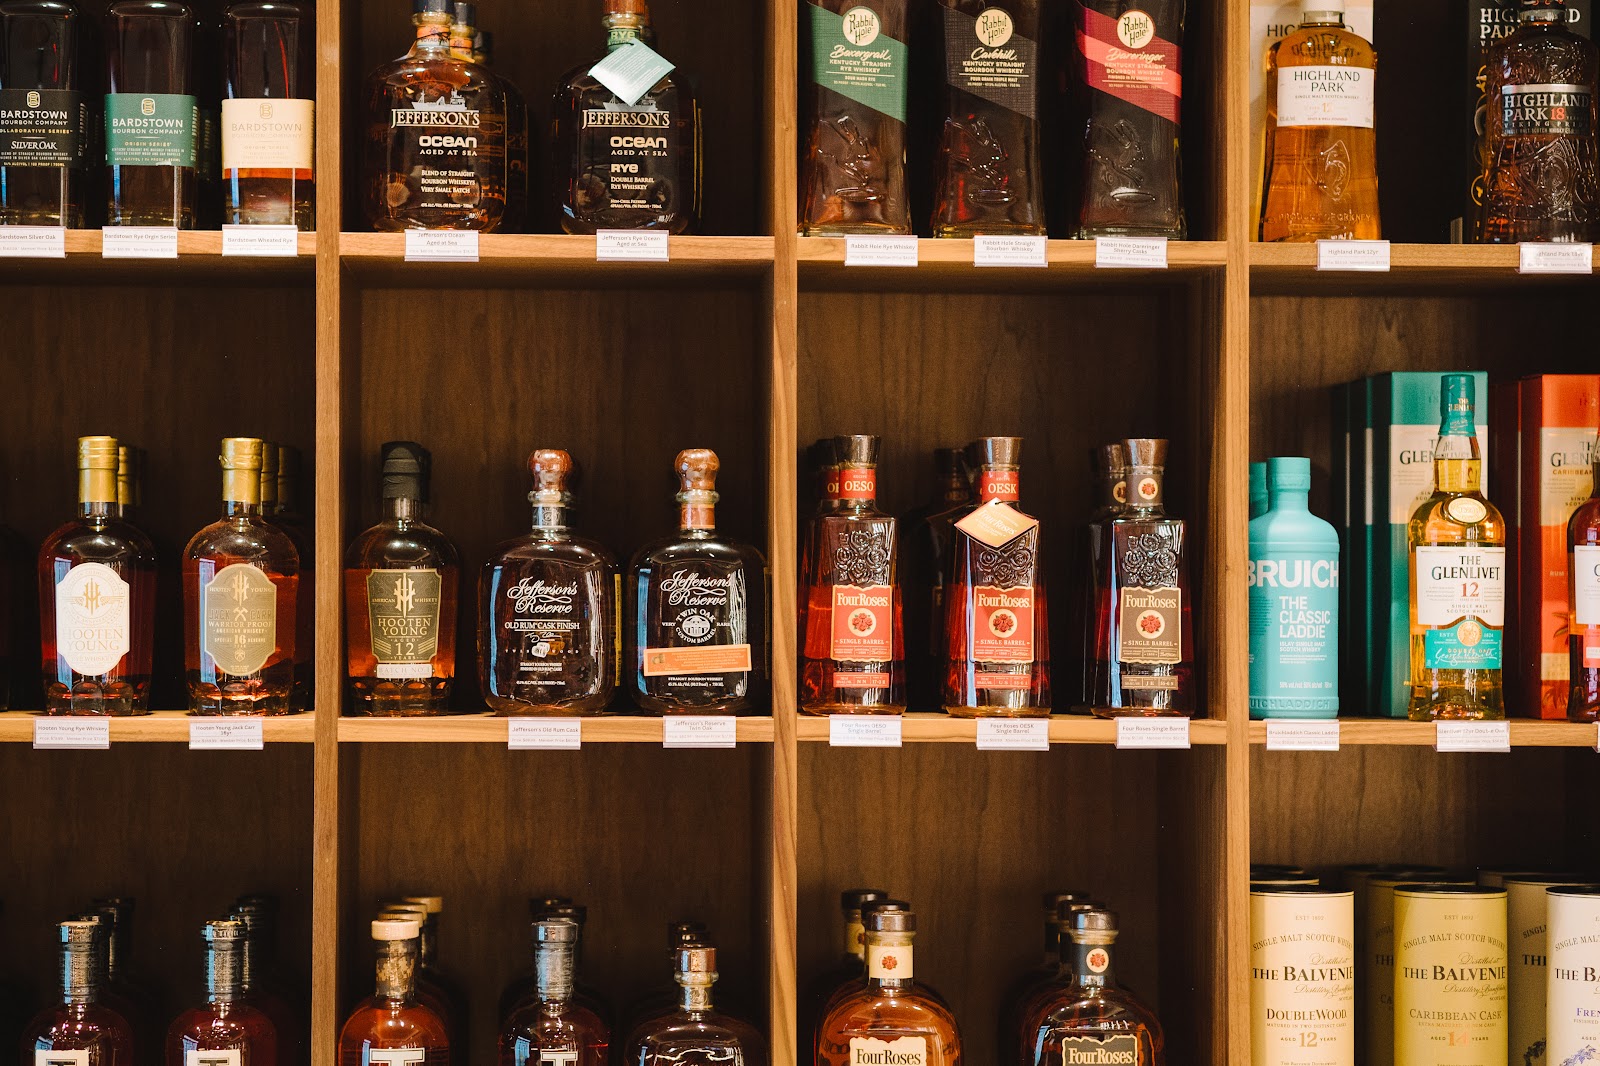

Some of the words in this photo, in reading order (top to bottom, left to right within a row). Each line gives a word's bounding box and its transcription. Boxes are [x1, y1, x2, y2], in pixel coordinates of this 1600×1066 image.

[849, 13, 875, 34] Rabbit
[982, 15, 1007, 34] Rabbit
[1123, 16, 1148, 36] Rabbit
[1294, 71, 1360, 81] HIGHLAND
[1311, 82, 1345, 92] PARK
[1503, 94, 1589, 108] HIGHLAND
[1, 110, 68, 119] BARDSTOWN
[391, 109, 480, 128] JEFFERSON'S
[582, 110, 670, 129] JEFFERSON'S
[1504, 107, 1549, 122] PARK
[1550, 107, 1566, 120] 18
[112, 118, 183, 127] BARDSTOWN
[231, 123, 302, 132] BARDSTOWN
[11, 141, 38, 150] SILVER
[38, 141, 58, 150] OAK
[844, 480, 874, 492] OESO
[988, 483, 1017, 494] OESK
[1459, 555, 1481, 565] THE
[1431, 566, 1500, 580] GLENLIVET
[507, 576, 577, 599] Jefferson's
[1461, 582, 1479, 598] 12
[515, 596, 572, 613] Reserve
[669, 589, 727, 606] Reserve
[1279, 596, 1308, 610] THE
[378, 618, 431, 628] HOOTEN
[676, 608, 697, 625] TWIN
[699, 608, 716, 625] OAK
[1279, 610, 1331, 624] CLASSIC
[382, 627, 427, 636] YOUNG
[1279, 625, 1326, 639] LADDIE
[67, 640, 119, 652] YOUNG
[396, 643, 415, 656] 12
[1253, 936, 1278, 951] SINGLE
[1280, 933, 1302, 943] MALT
[1306, 933, 1335, 943] SCOTCH
[1403, 936, 1427, 951] SINGLE
[1429, 933, 1451, 943] MALT
[1455, 933, 1486, 943] SCOTCH
[1252, 967, 1279, 981] THE
[1283, 966, 1353, 981] BALVENIE
[1403, 967, 1428, 980] THE
[1432, 965, 1506, 981] BALVENIE
[1554, 967, 1579, 981] THE
[1267, 1008, 1347, 1021] DOUBLEWOOD
[1409, 1008, 1477, 1020] CARIBBEAN
[1479, 1009, 1502, 1020] CASK
[1298, 1031, 1318, 1047] 12
[1448, 1031, 1469, 1047] 14
